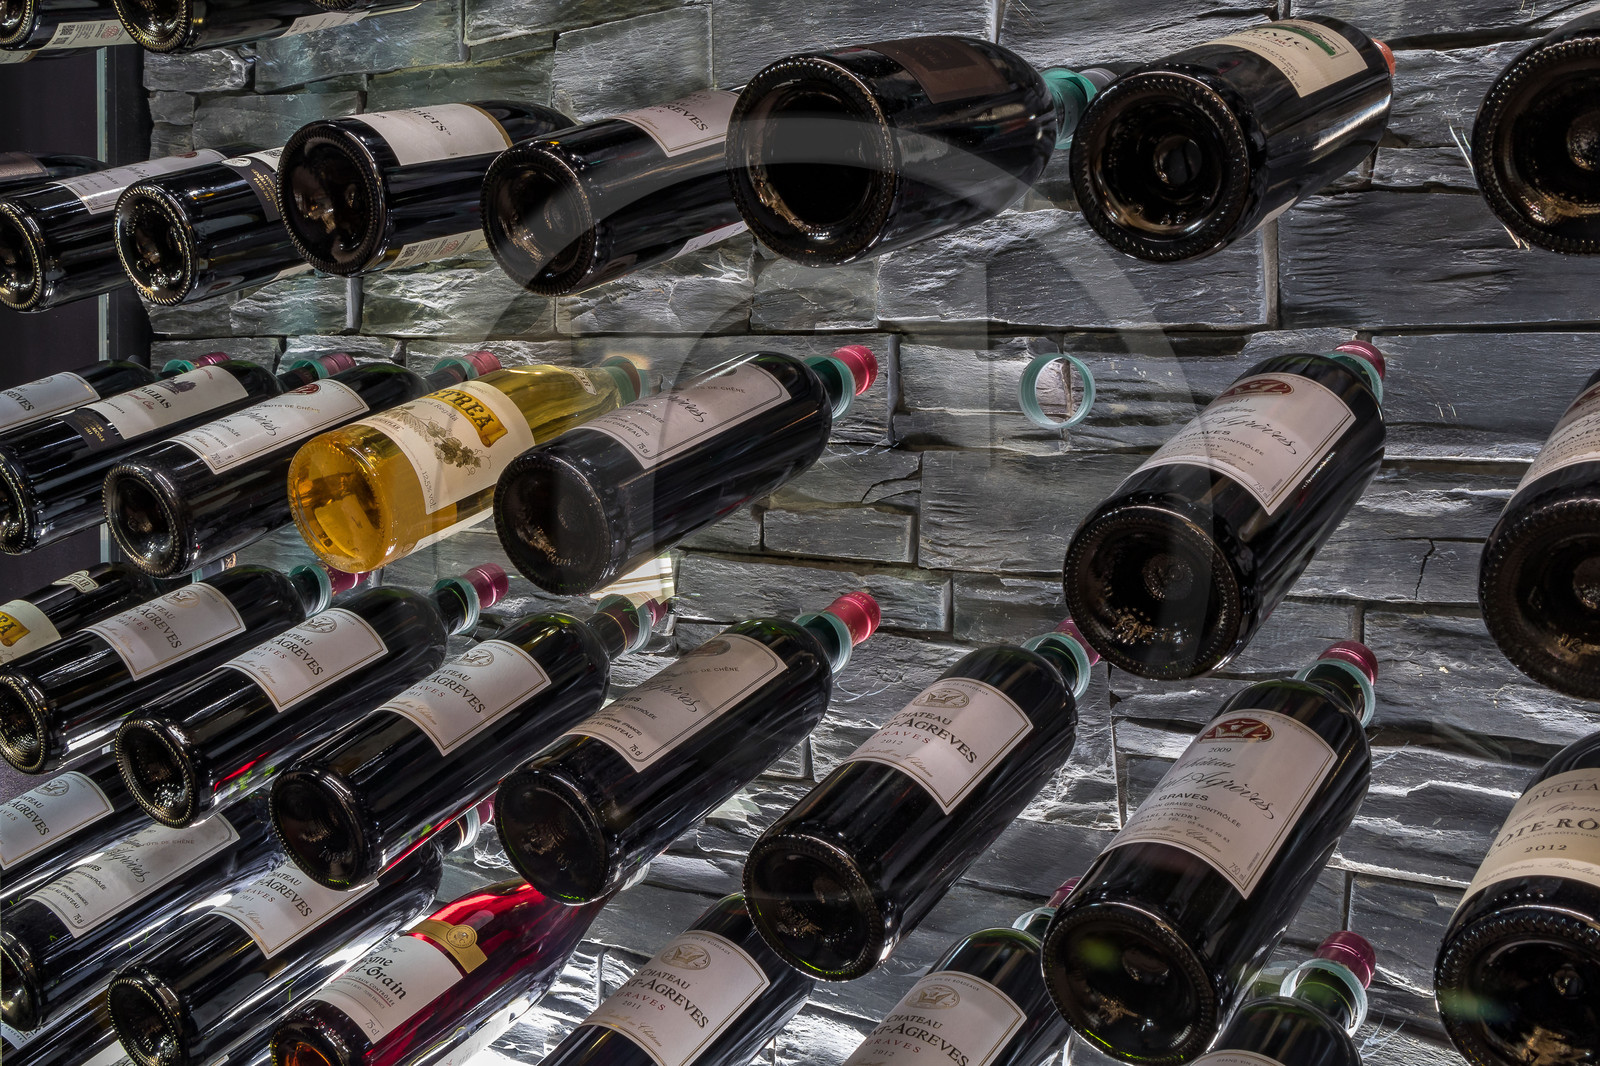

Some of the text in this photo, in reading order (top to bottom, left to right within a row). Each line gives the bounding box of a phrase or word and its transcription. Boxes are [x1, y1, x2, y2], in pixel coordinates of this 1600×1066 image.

[893, 711, 953, 726] CHATEAU
[629, 743, 638, 752] 75
[1158, 792, 1209, 801] GRAVES
[1523, 844, 1568, 853] 2012
[1228, 861, 1242, 874] 750
[640, 968, 691, 990] CHATEAU
[622, 1000, 642, 1010] 2011
[365, 1019, 375, 1031] 75
[886, 1014, 944, 1030] CHATEAU
[873, 1049, 895, 1057] 2012
